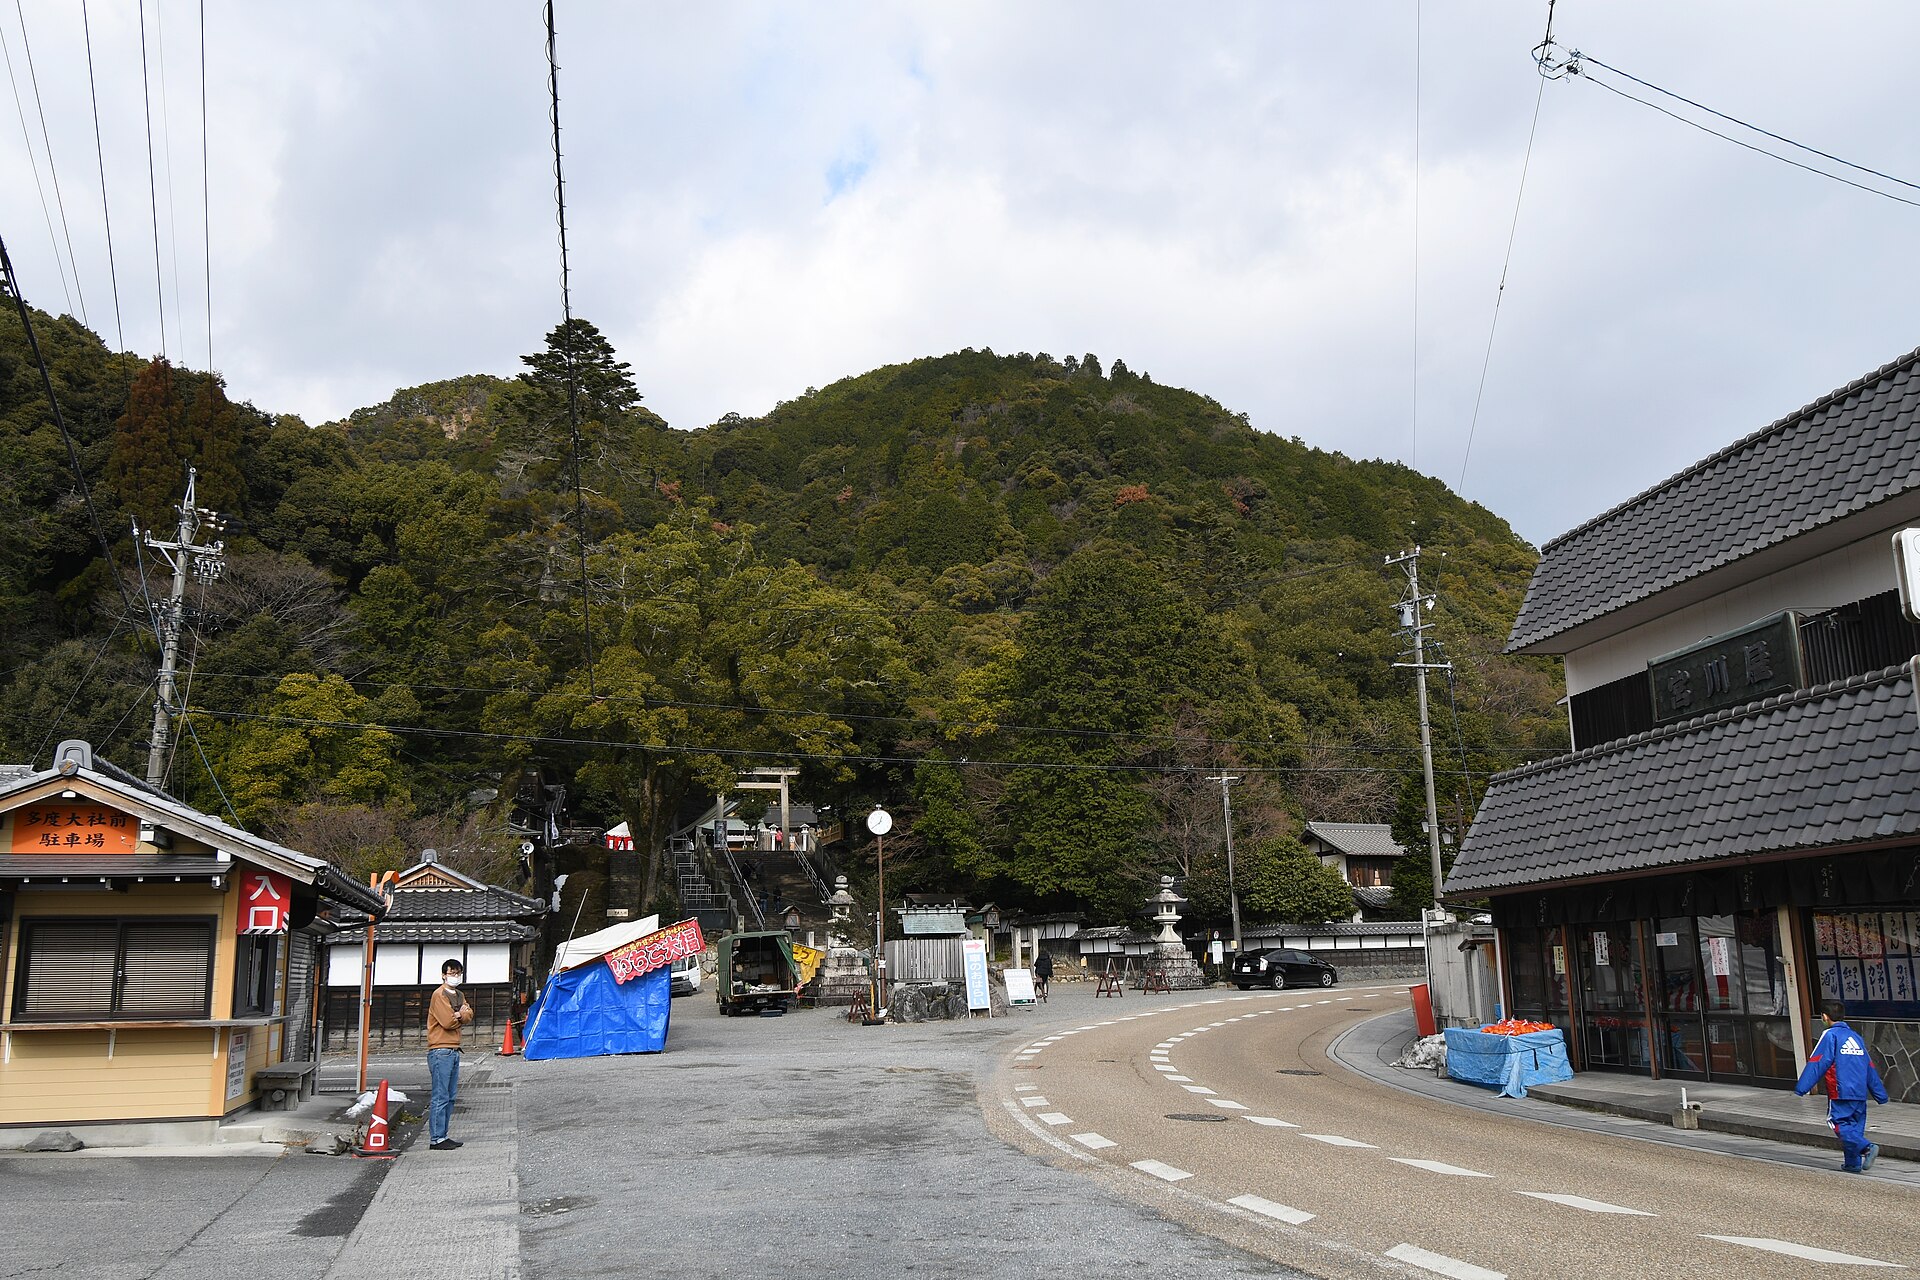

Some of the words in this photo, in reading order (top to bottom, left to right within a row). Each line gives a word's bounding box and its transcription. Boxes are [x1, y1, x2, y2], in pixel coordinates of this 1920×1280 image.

[1666, 640, 1774, 710] 宮川屋
[24, 811, 129, 828] 多度大社前
[39, 832, 105, 848] 駐車場
[249, 875, 281, 930] 入口
[1890, 916, 1900, 950] うどん
[611, 927, 701, 980] いちご大福
[968, 953, 985, 1006] 車のおはらい
[1820, 972, 1831, 987] 酒
[1843, 966, 1855, 993] 紅茶
[1868, 965, 1876, 997] カレー
[1876, 962, 1885, 999] カツカレー
[1895, 964, 1907, 1000] カツ丼
[1840, 1047, 1864, 1056] adidas
[369, 1113, 388, 1147] 入口
